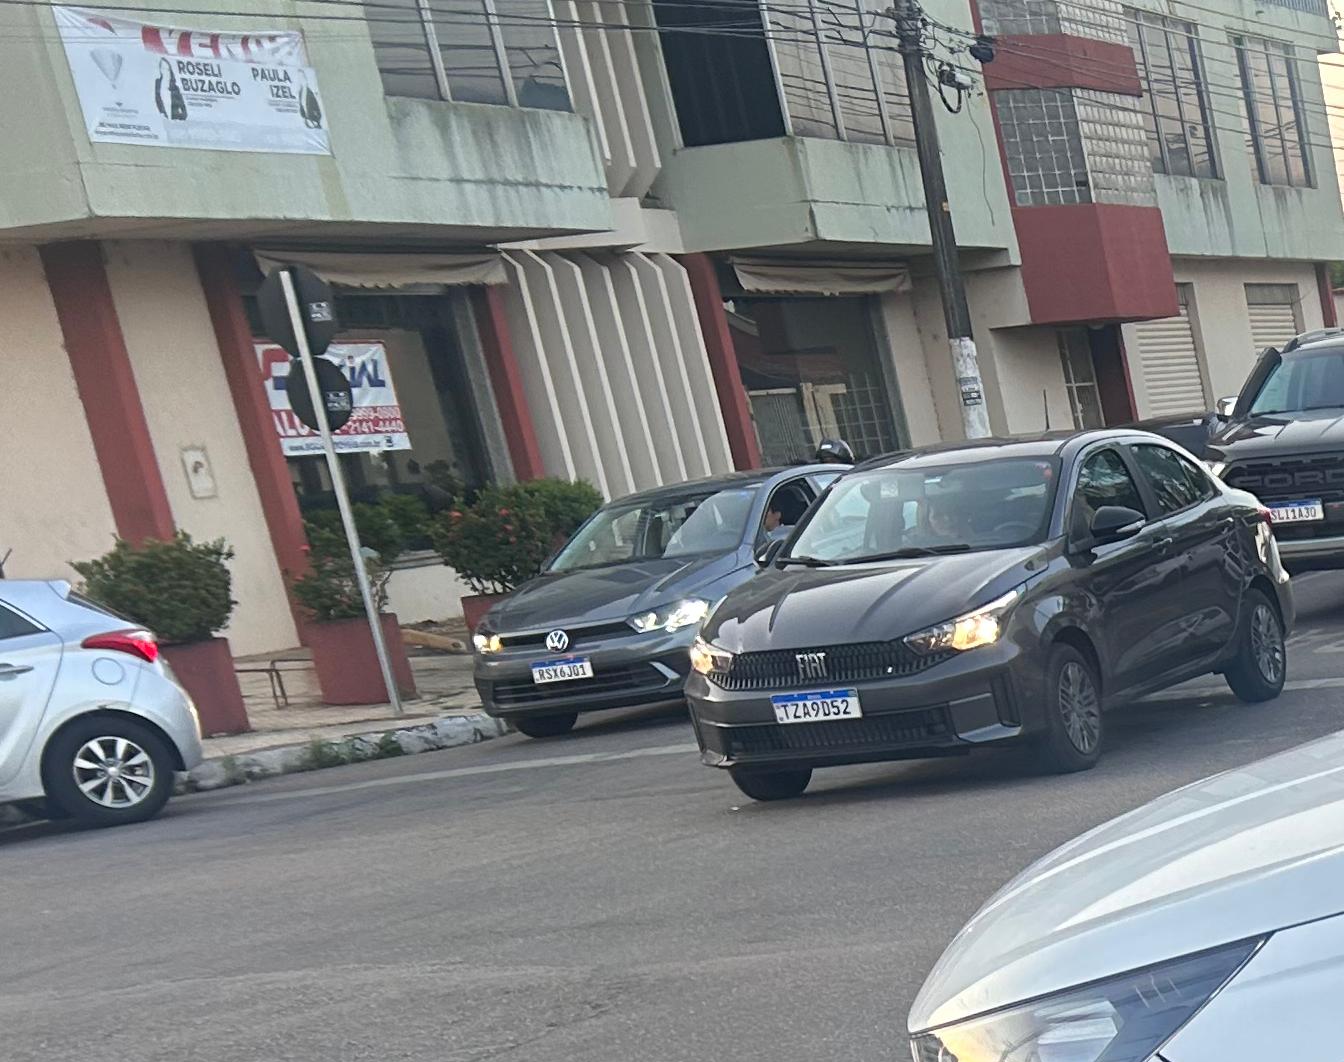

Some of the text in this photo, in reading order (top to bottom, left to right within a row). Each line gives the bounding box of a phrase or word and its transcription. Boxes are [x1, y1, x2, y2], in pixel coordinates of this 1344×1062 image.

[177, 60, 222, 78] ROSELI
[251, 67, 292, 84] PAULA
[180, 78, 241, 96] BUZAGLO
[269, 84, 296, 99] IZEL
[795, 652, 828, 679] FIAT
[781, 699, 852, 720] TZA9D52
